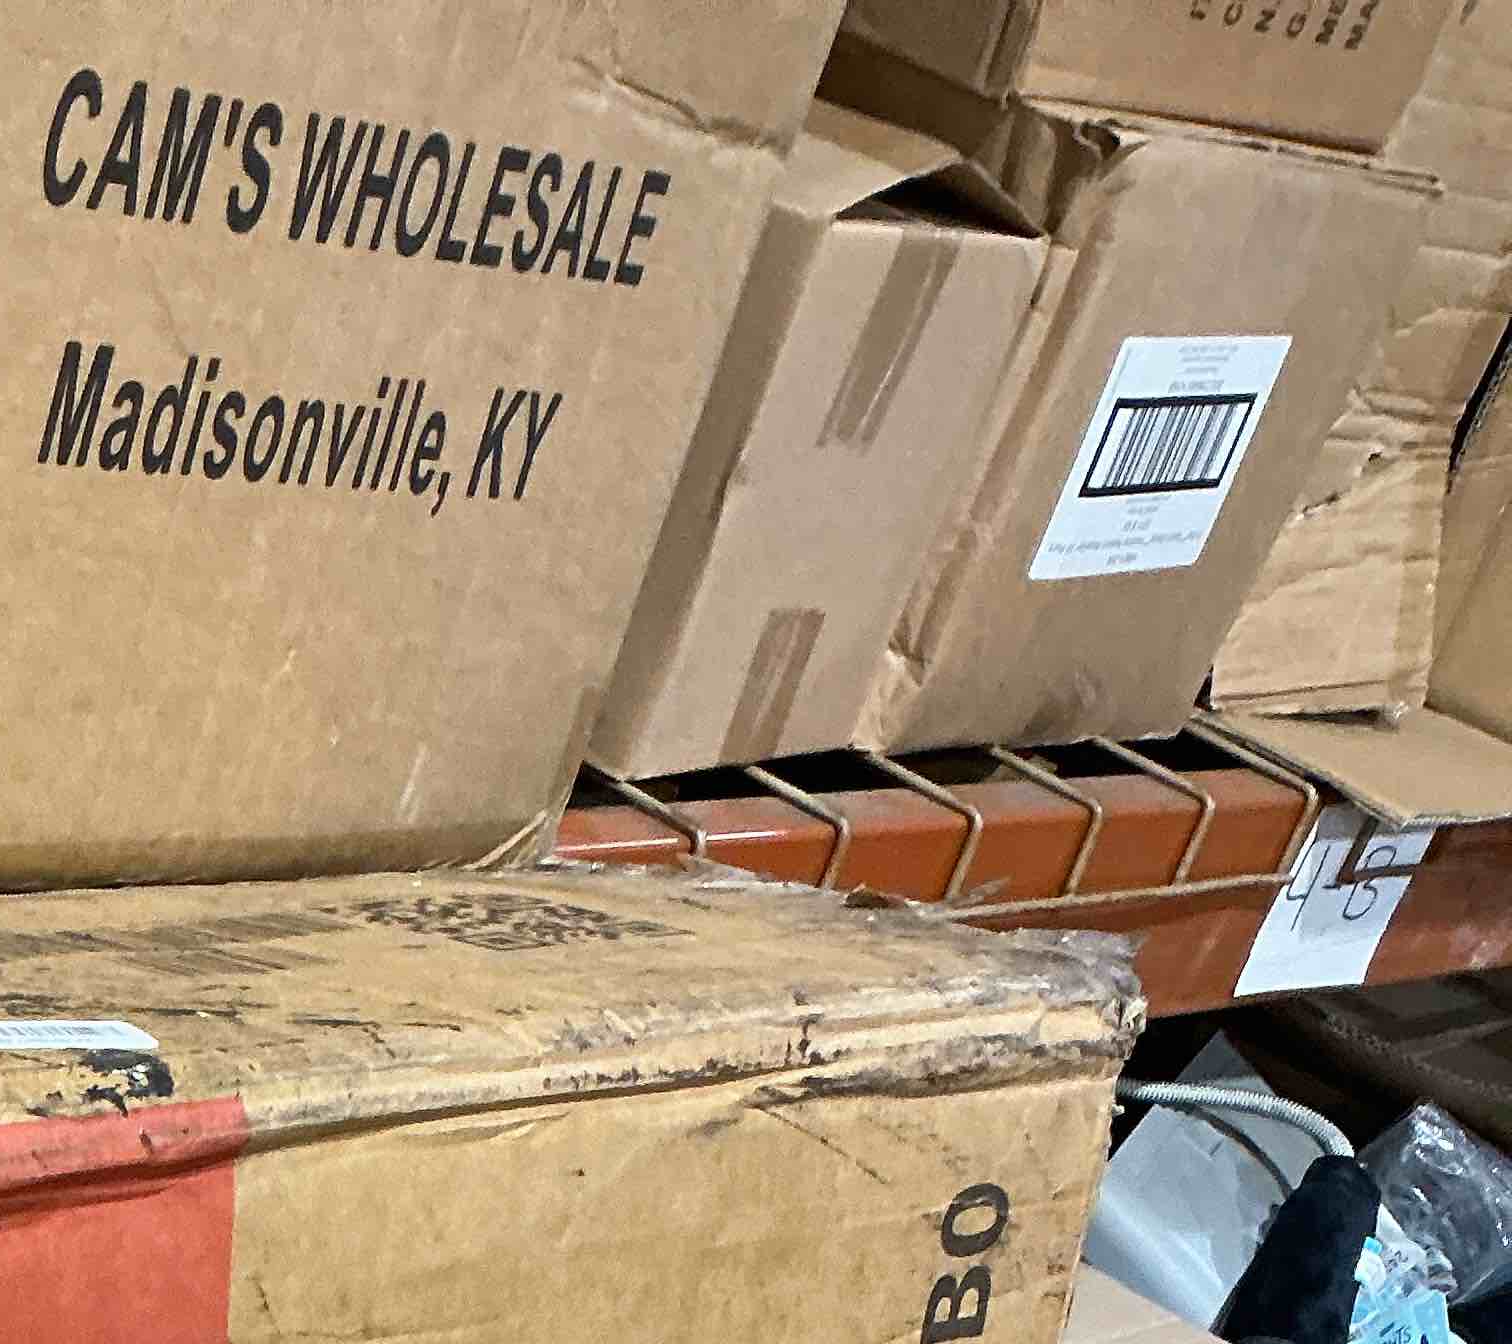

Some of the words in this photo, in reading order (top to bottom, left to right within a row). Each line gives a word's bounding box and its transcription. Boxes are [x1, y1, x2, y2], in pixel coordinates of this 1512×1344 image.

[41, 68, 284, 235] CAM'S
[287, 112, 671, 288] WHOLESALE
[37, 340, 451, 517] Madisonville,
[466, 387, 563, 502] KY
